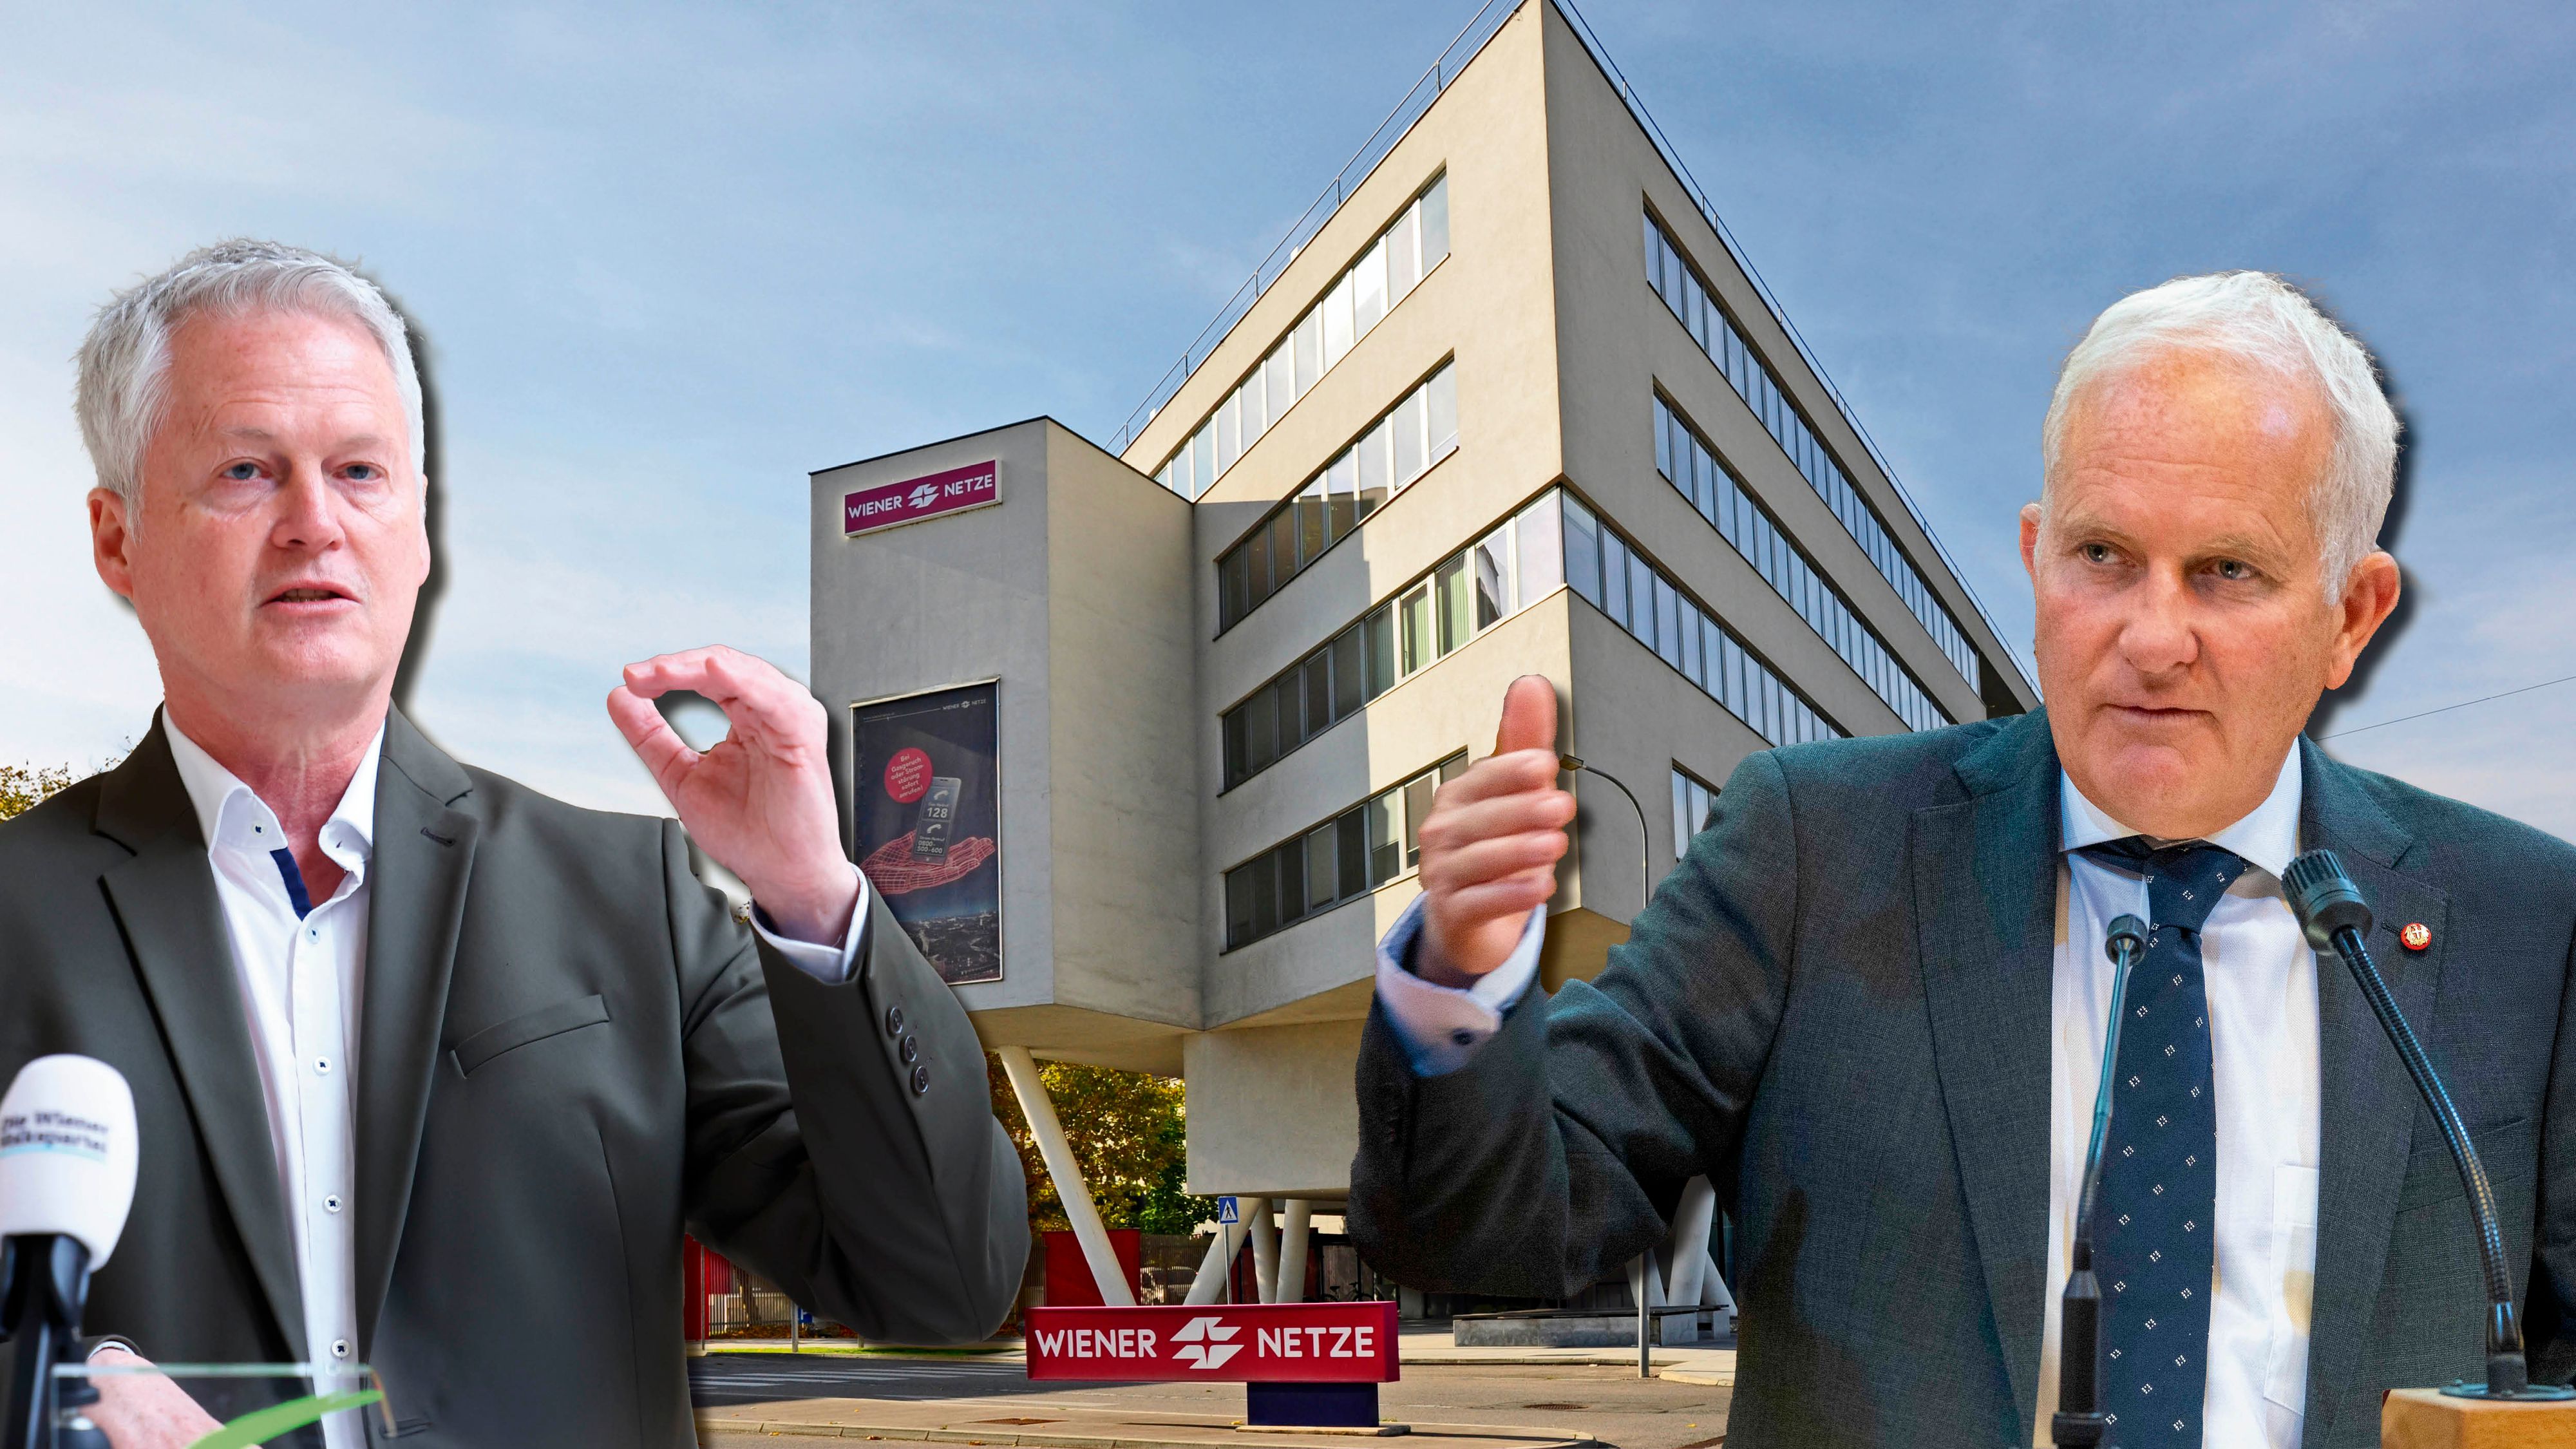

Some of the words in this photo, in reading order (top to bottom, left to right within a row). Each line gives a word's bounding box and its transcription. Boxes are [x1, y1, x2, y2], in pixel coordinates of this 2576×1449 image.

[848, 495, 902, 518] WIENER
[944, 474, 993, 497] NETZE
[900, 753, 910, 762] Bei
[891, 757, 922, 772] Gasgeruch
[898, 773, 920, 784] störung
[902, 780, 919, 790] sofort
[899, 784, 923, 799] anrufen!
[927, 807, 948, 818] 128
[1034, 1329, 1158, 1358] WIENER
[1258, 1326, 1376, 1358] NETZE
